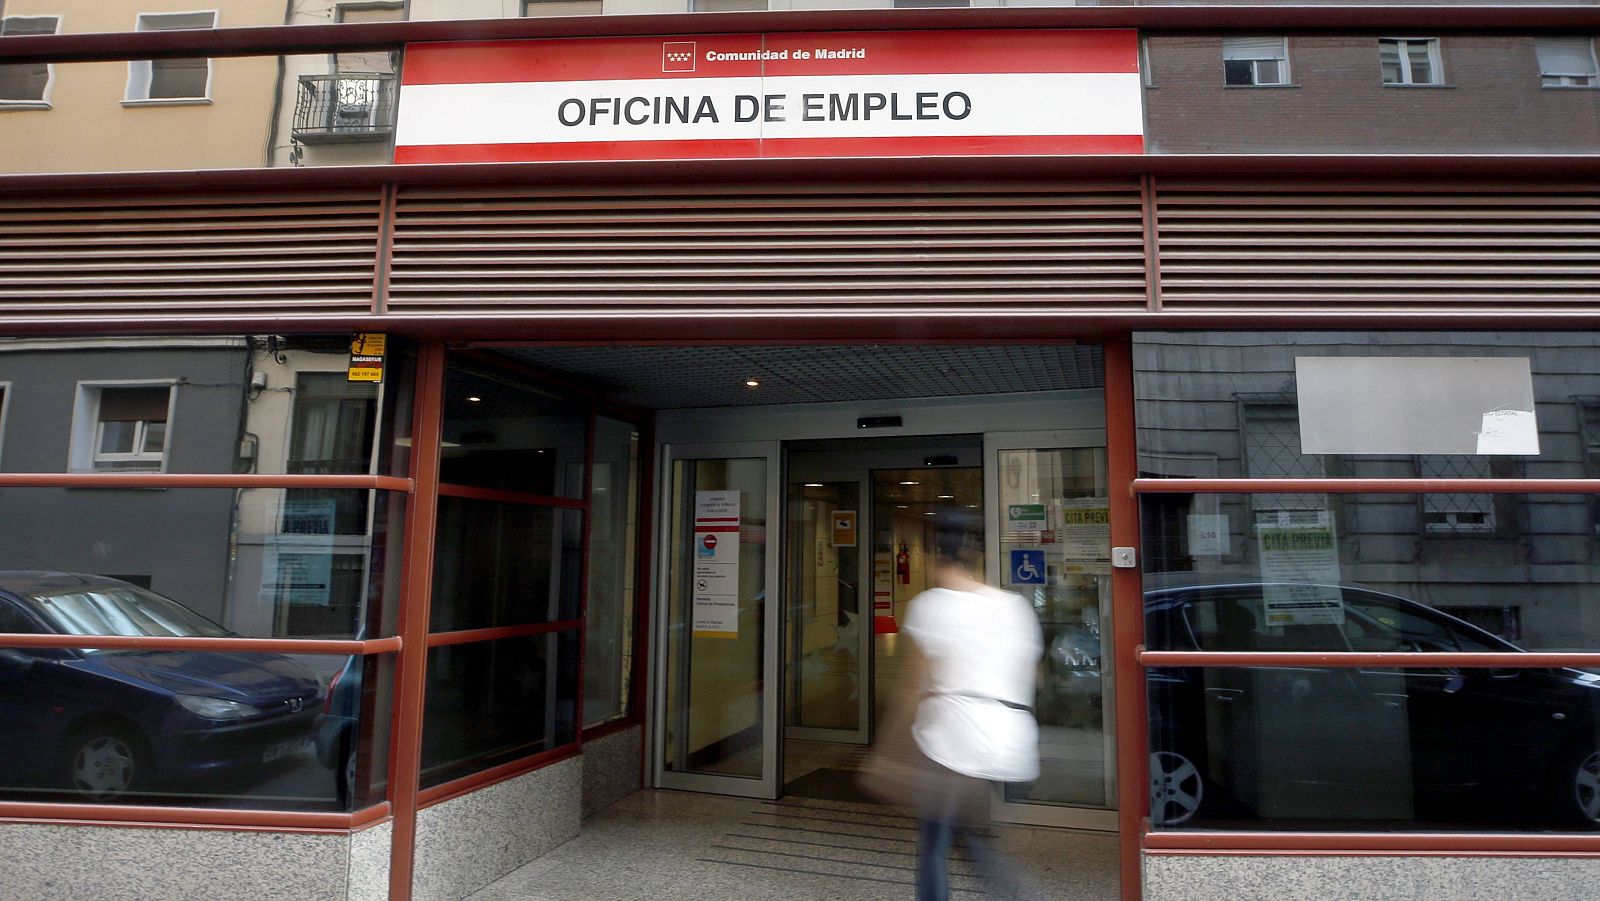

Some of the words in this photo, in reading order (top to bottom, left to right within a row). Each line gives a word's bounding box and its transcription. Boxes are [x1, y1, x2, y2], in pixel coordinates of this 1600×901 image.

[705, 50, 788, 61] Comunidad
[792, 49, 811, 60] de
[814, 48, 865, 60] Madrid
[557, 95, 720, 126] OFICINA
[734, 94, 787, 122] DE
[802, 91, 971, 121] EMPLEO
[1065, 512, 1082, 524] CITA
[1084, 511, 1109, 524] PREVI
[1264, 533, 1289, 550] CITA
[1291, 532, 1332, 549] PREVIA
